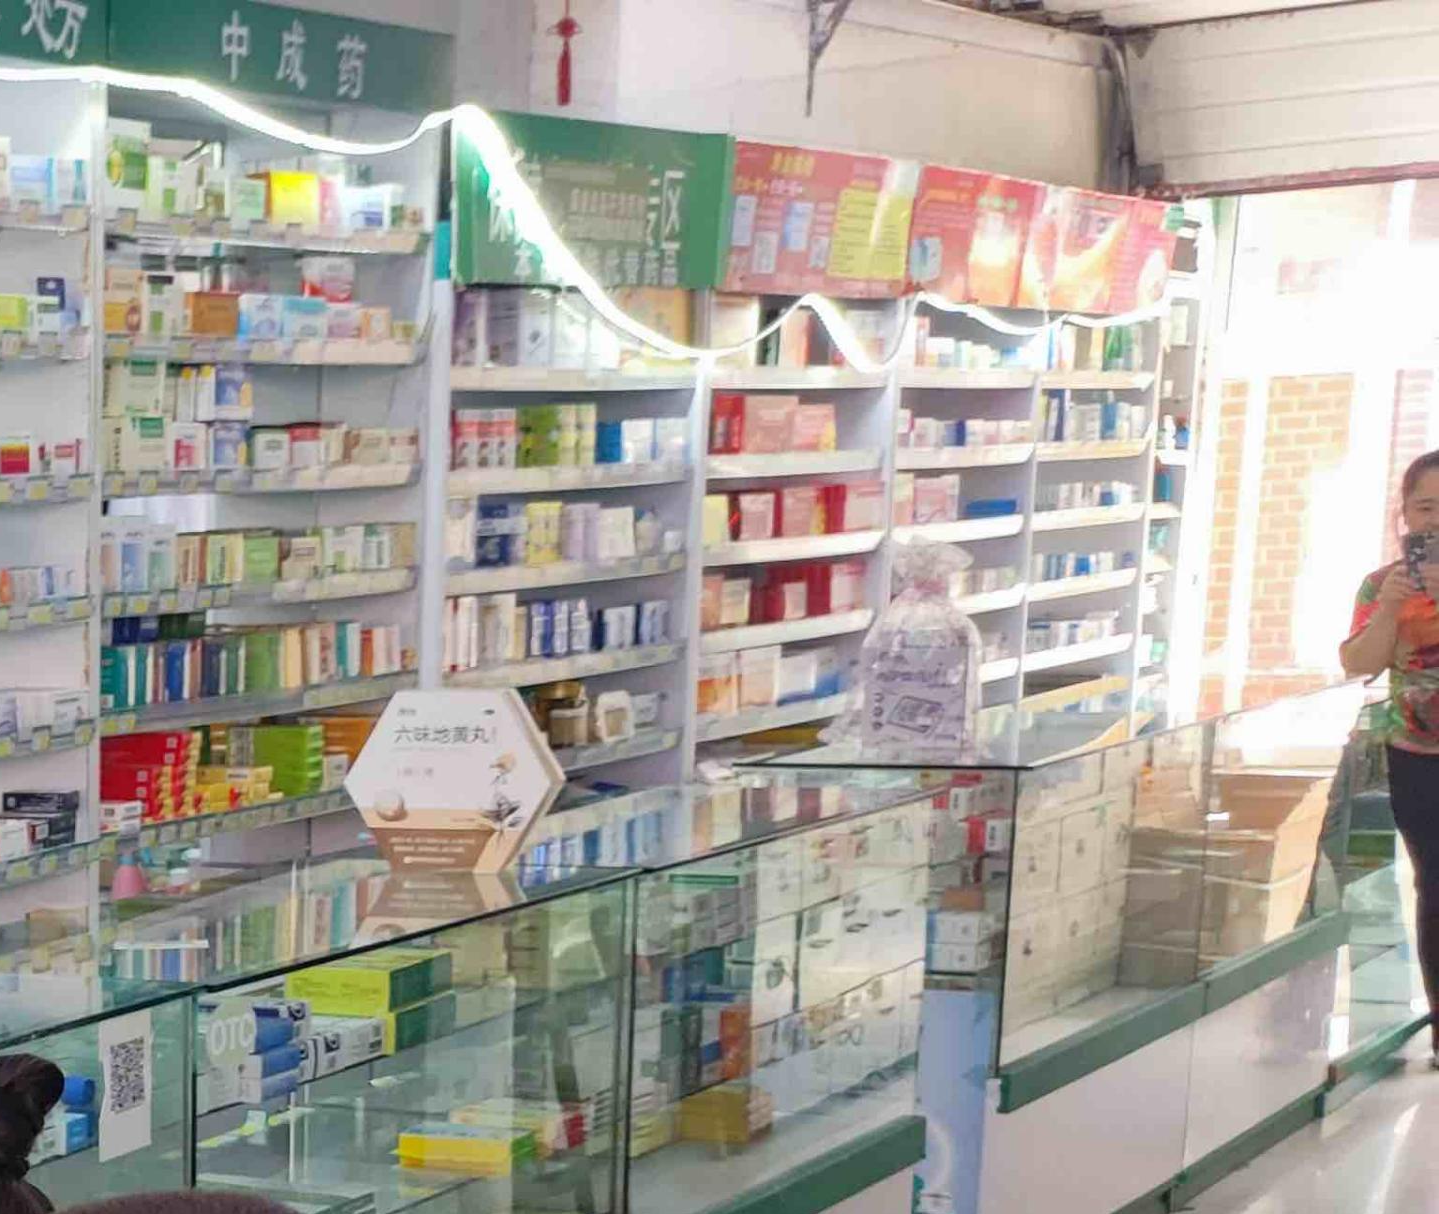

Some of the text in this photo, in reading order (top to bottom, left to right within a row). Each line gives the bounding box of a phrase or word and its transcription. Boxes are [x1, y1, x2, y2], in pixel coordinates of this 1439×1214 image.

[221, 12, 367, 99] 中成药
[393, 724, 490, 746] 六味地黄丸
[206, 1012, 257, 1057] OTC
